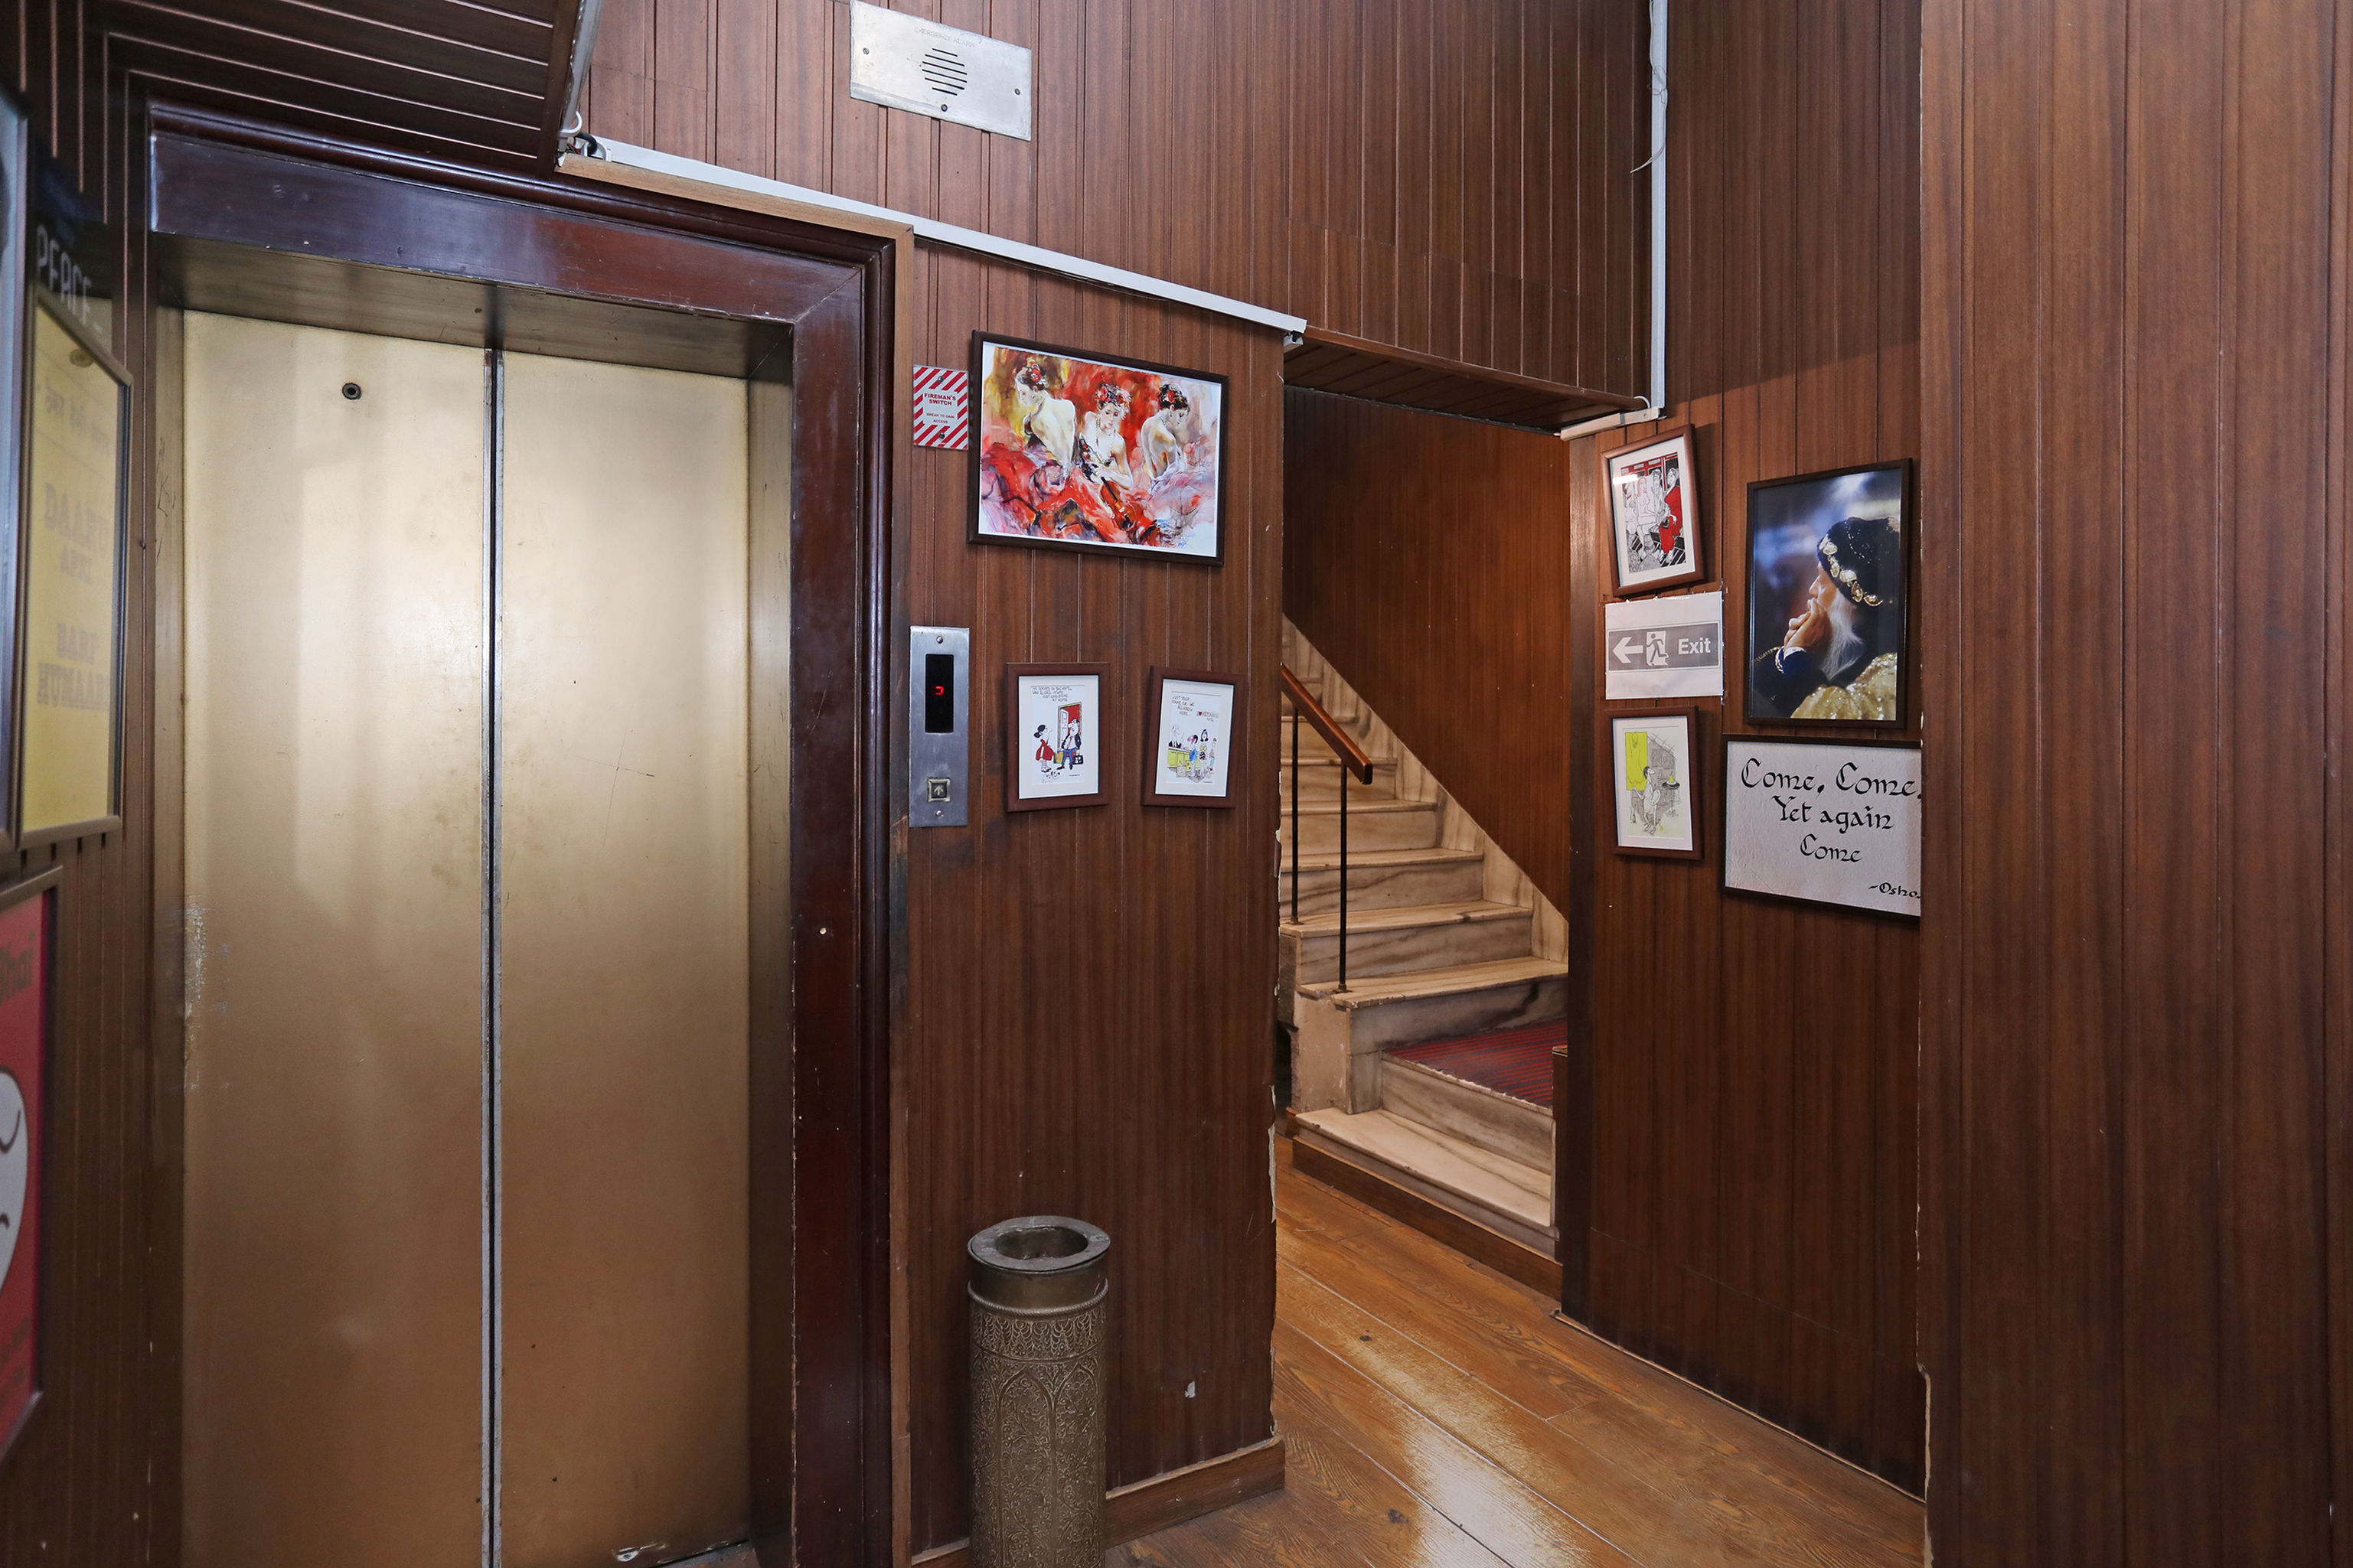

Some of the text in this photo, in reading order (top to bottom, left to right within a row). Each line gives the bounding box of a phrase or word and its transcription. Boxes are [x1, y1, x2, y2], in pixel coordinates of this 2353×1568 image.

[924, 393, 956, 401] FIREMAN'S
[1678, 637, 1712, 655] Exit
[1741, 758, 1826, 798] Come,
[1771, 795, 1894, 833] Yet again
[1800, 833, 1862, 863] Come
